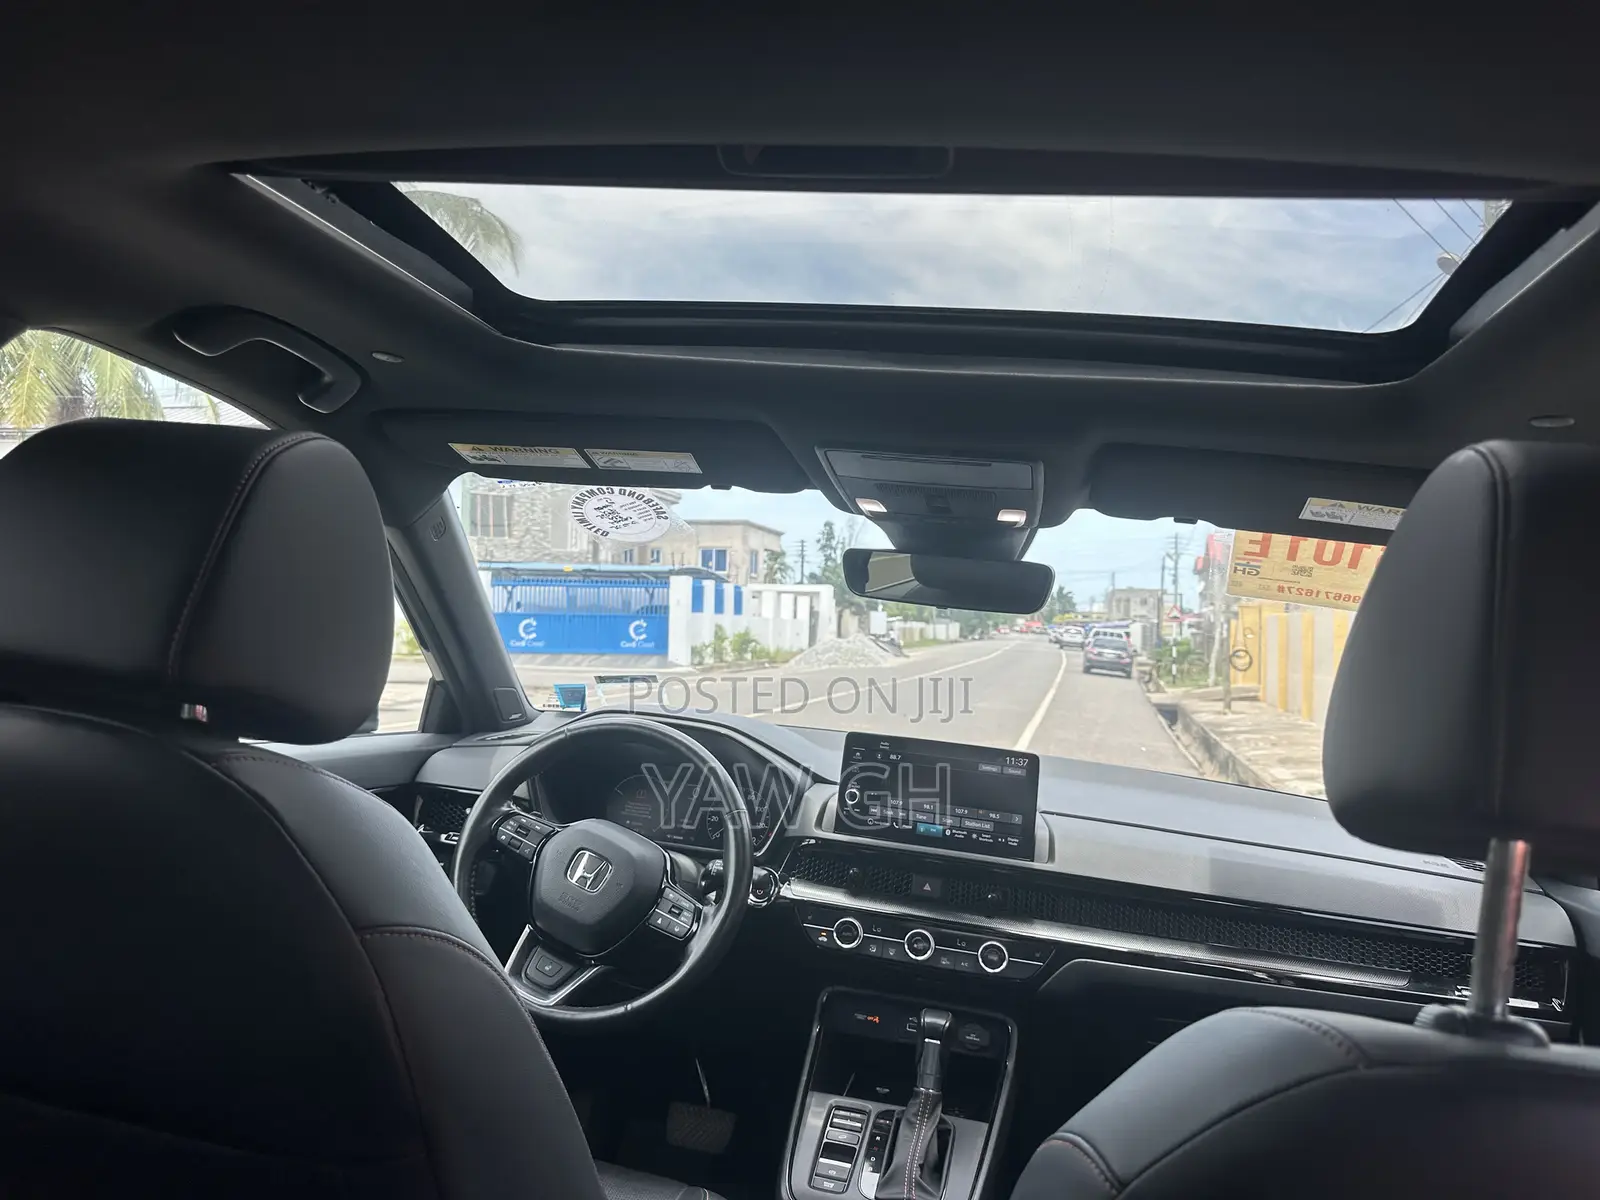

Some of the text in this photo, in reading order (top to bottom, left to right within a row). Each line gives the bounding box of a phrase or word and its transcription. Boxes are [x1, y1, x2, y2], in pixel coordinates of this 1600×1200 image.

[488, 446, 560, 454] WARNING
[1357, 504, 1405, 516] WAR
[1005, 756, 1029, 767] 11:37
[964, 820, 981, 828] Station
[956, 938, 967, 947] Lo
